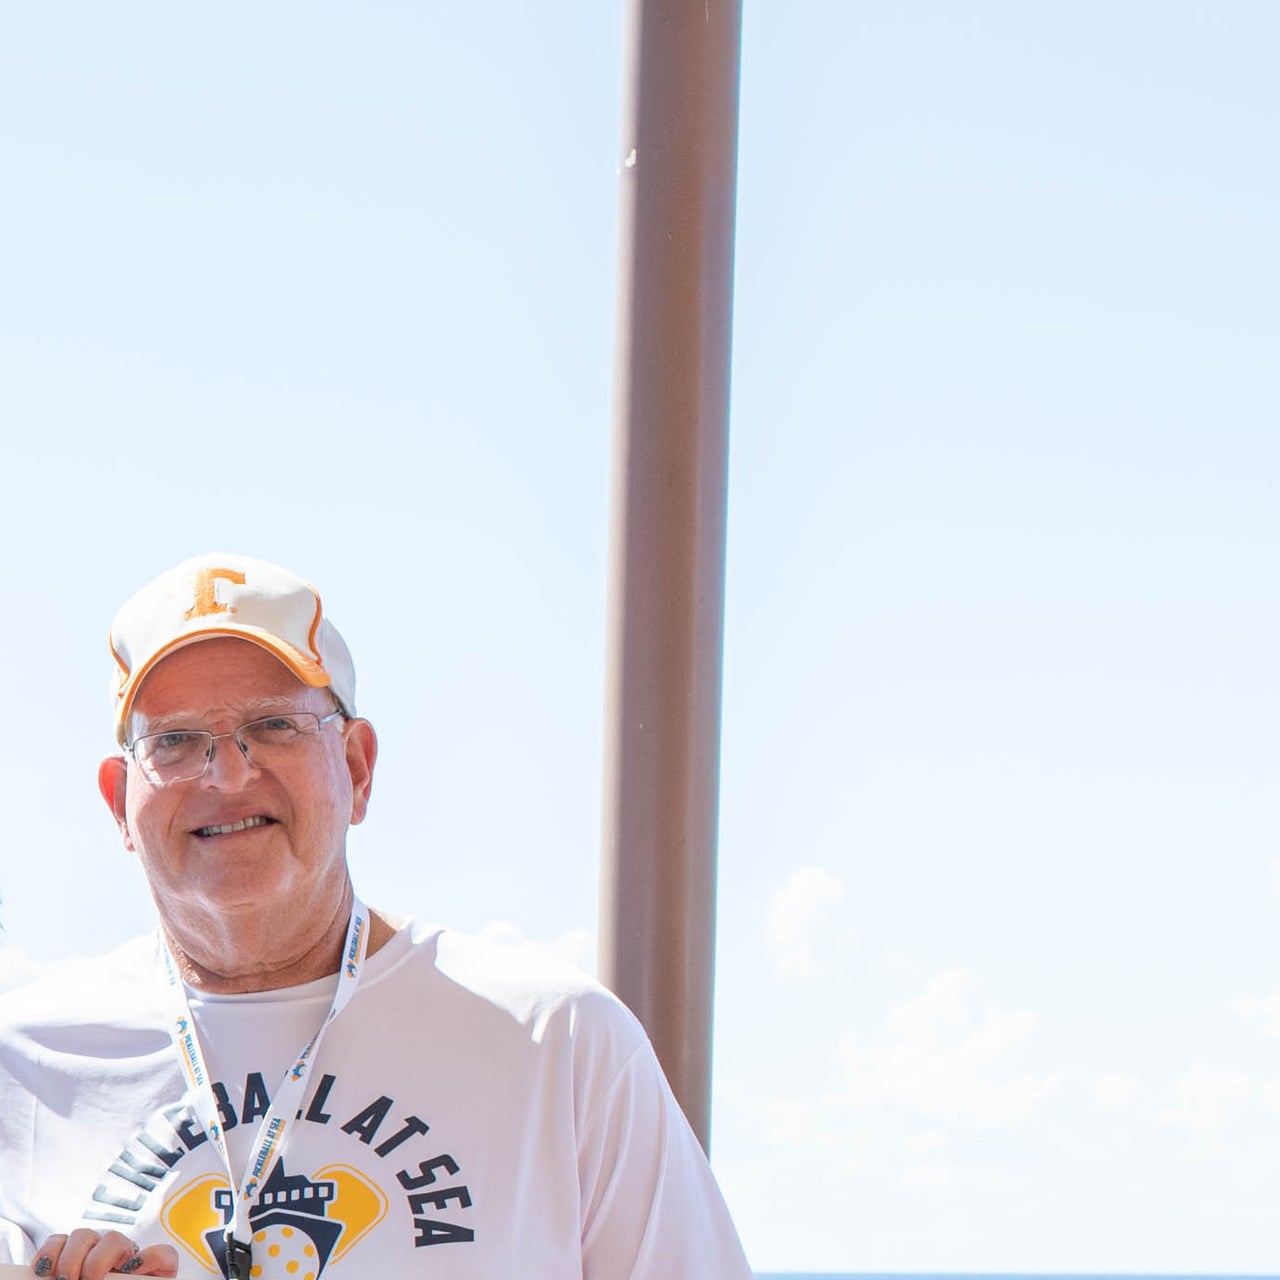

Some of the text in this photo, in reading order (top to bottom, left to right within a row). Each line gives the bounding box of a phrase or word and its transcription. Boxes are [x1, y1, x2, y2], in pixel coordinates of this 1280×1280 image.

[82, 1071, 337, 1232] ICKLEBAL
[339, 1095, 430, 1158] AT
[395, 1153, 475, 1248] SEA
